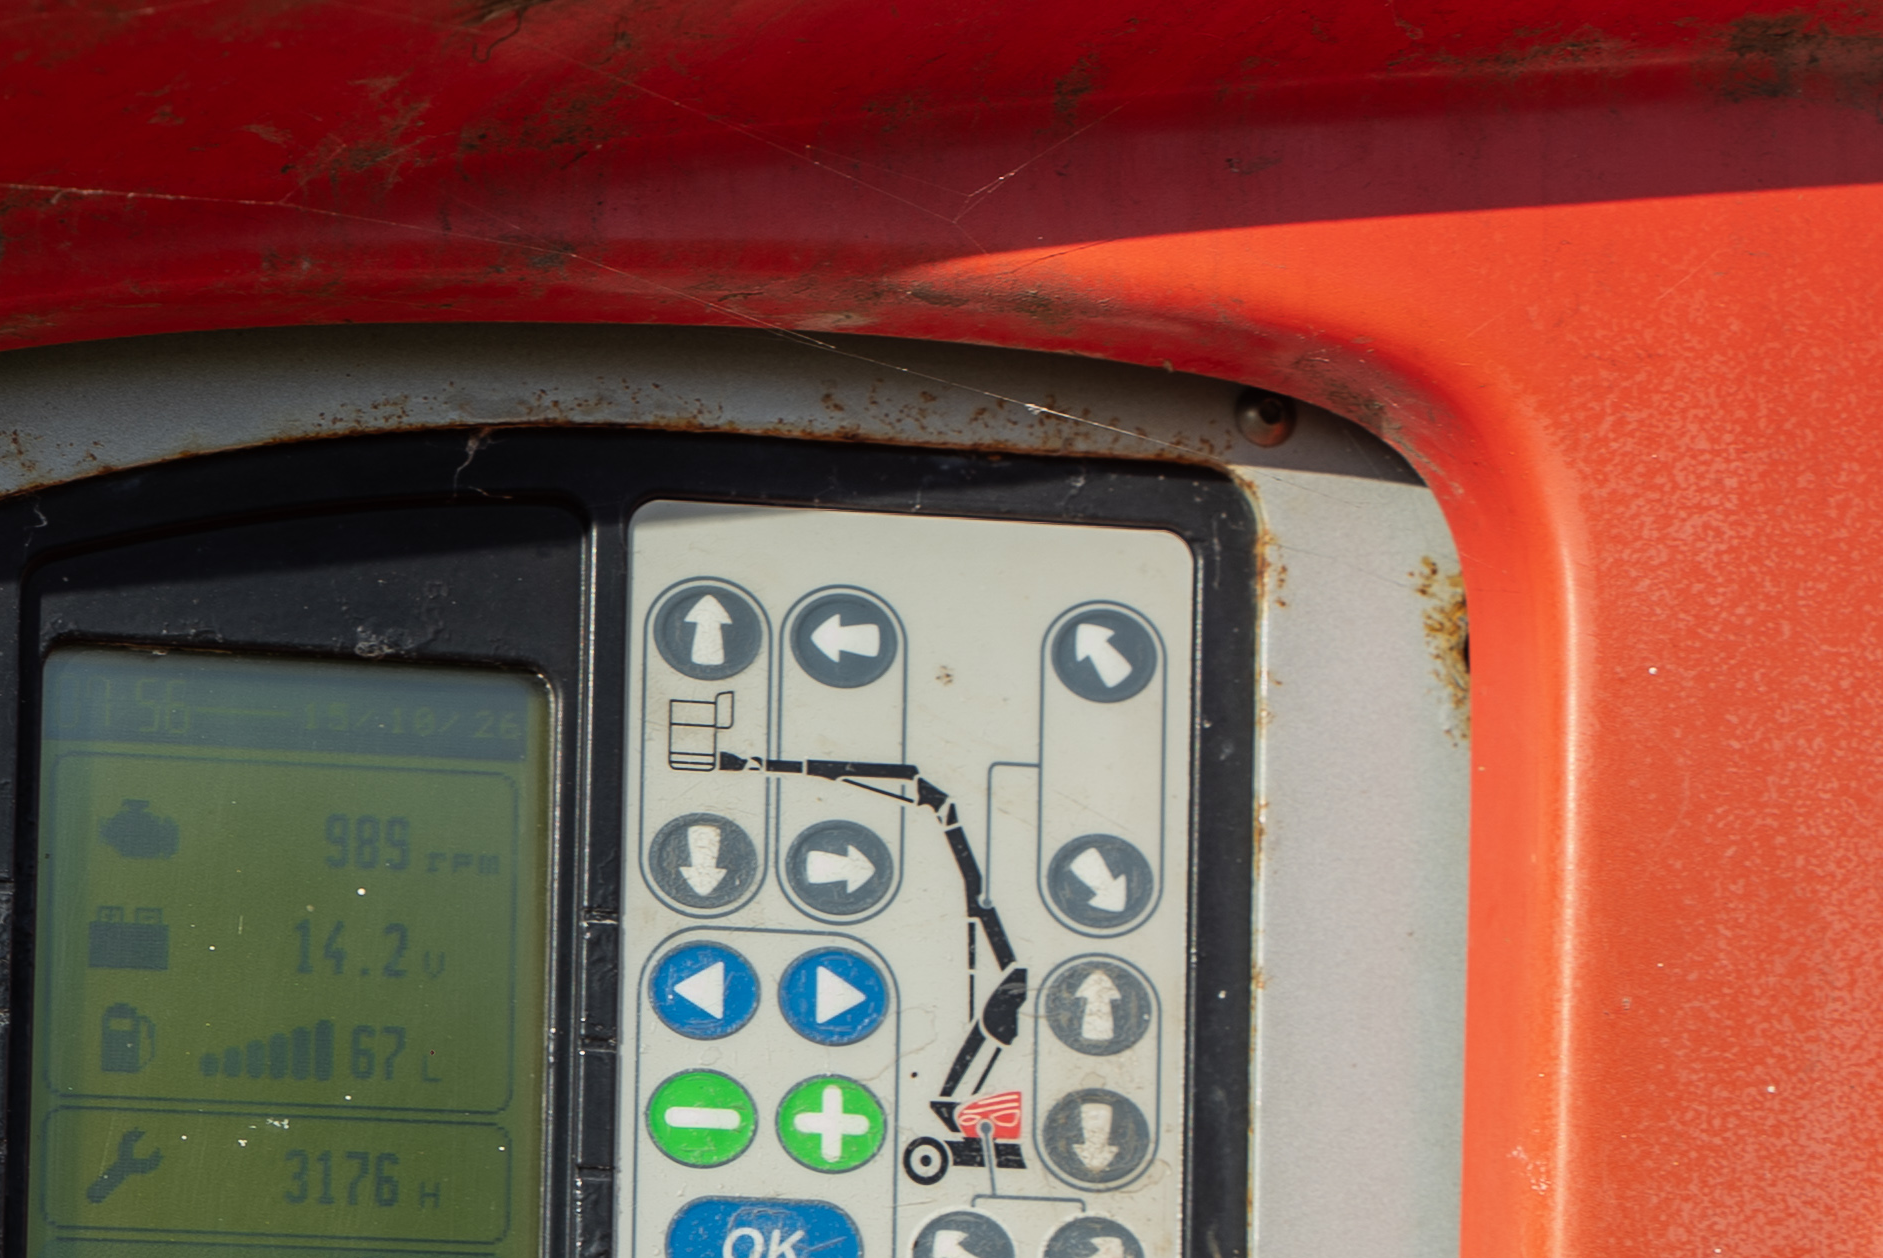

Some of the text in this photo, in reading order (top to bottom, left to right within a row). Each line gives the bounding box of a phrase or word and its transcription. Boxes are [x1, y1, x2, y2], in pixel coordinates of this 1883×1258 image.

[325, 813, 411, 871] 989
[294, 918, 408, 978] 14.2
[351, 1024, 443, 1083] 67 L
[284, 1150, 441, 1208] 3176 H
